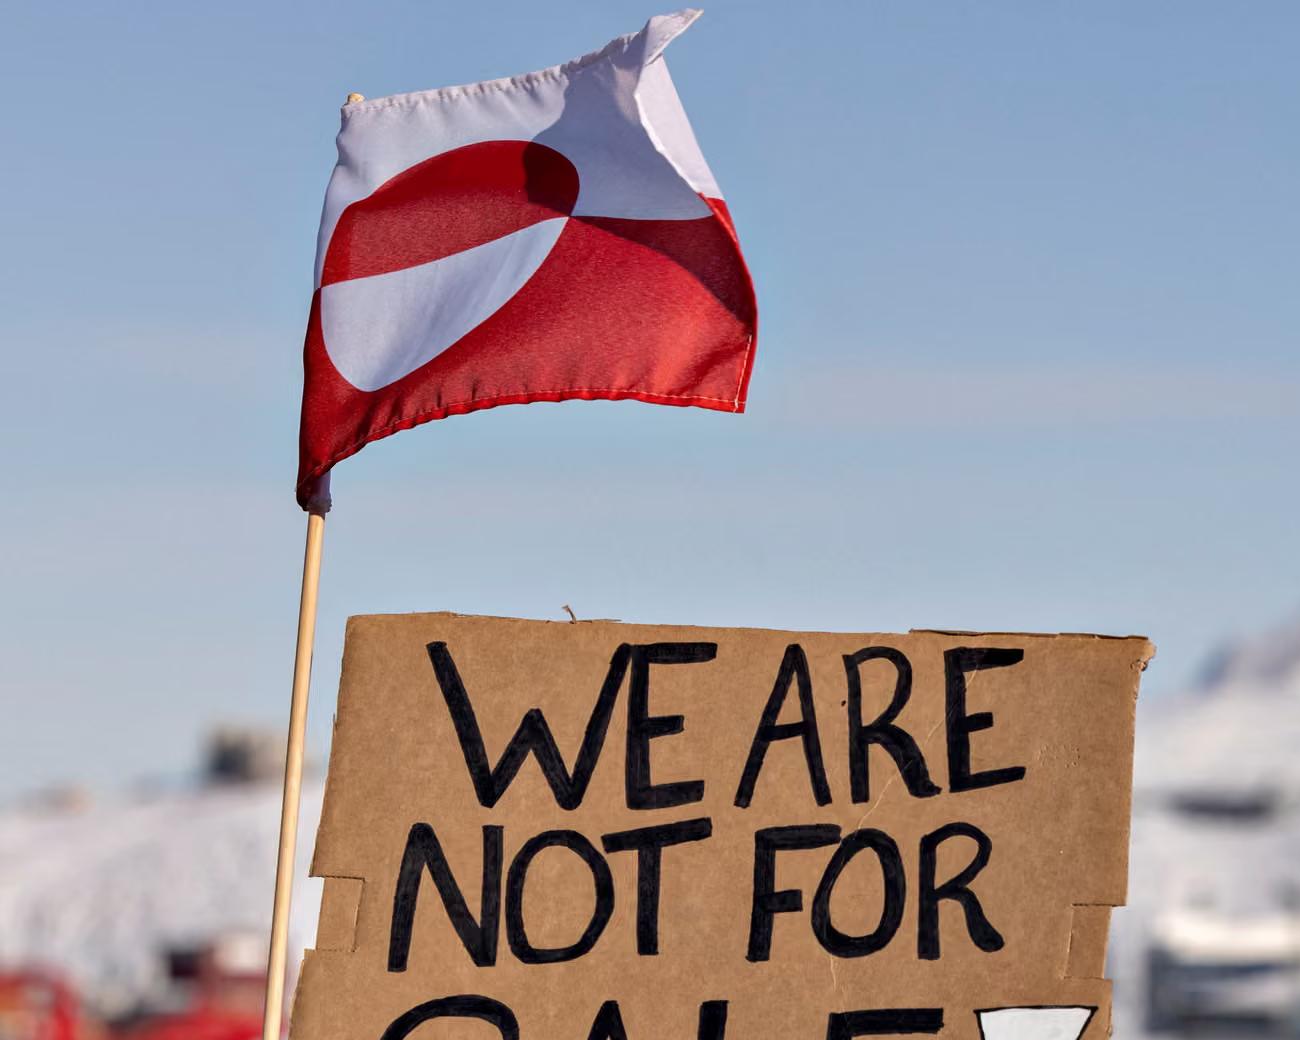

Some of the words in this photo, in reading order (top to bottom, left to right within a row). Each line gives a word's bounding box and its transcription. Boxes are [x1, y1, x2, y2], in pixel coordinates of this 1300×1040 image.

[425, 640, 719, 811] WE
[733, 643, 1027, 810] ARE
[387, 817, 713, 973] NOT
[744, 821, 1006, 963] FOR
